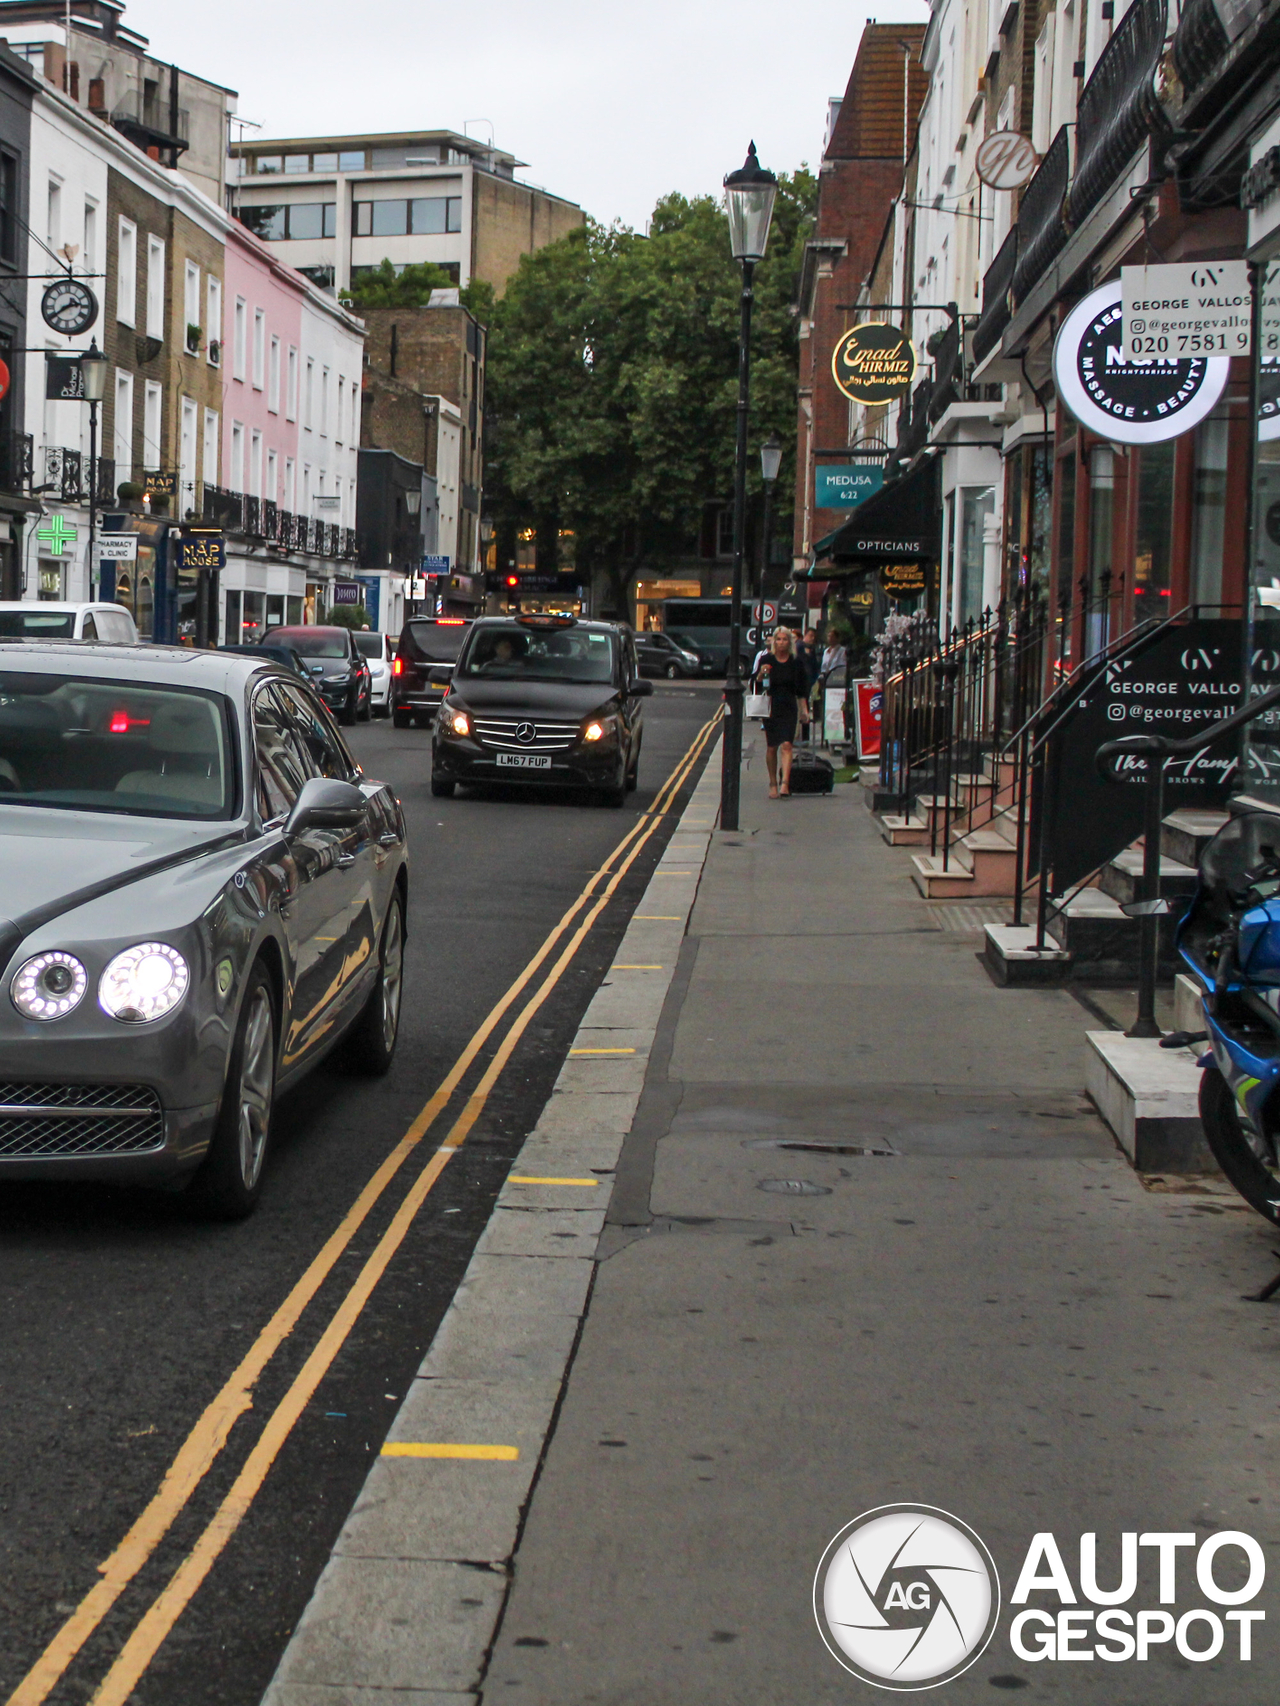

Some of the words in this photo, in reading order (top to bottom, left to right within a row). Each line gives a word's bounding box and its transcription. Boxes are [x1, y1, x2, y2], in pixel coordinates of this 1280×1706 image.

[1131, 298, 1190, 312] GEORGE
[1197, 295, 1252, 308] VALLOS
[1093, 307, 1123, 336] AES
[1148, 315, 1251, 334] @georgevallo
[1131, 336, 1169, 354] 020
[1177, 333, 1228, 352] 7581
[843, 337, 904, 367] Emad
[858, 360, 910, 373] HIRMIZ
[69, 366, 78, 397] Michael
[1081, 356, 1135, 418] MASSAGE
[1155, 357, 1203, 415] BEAUTY
[146, 477, 174, 487] MAP
[826, 475, 872, 486] MEDUSA
[146, 486, 173, 494] HOUSE
[107, 549, 128, 557] CLINIC
[182, 544, 220, 557] MAP
[857, 541, 920, 552] OPTICIANS
[182, 556, 220, 567] HOUSE
[1110, 682, 1178, 695] GEORGE
[1188, 683, 1242, 695] VALLO
[1129, 703, 1236, 723] @georgevall
[500, 755, 526, 766] LM67
[528, 757, 548, 767] FUP
[1162, 744, 1240, 785] Hamp
[1167, 776, 1206, 784] BROWS
